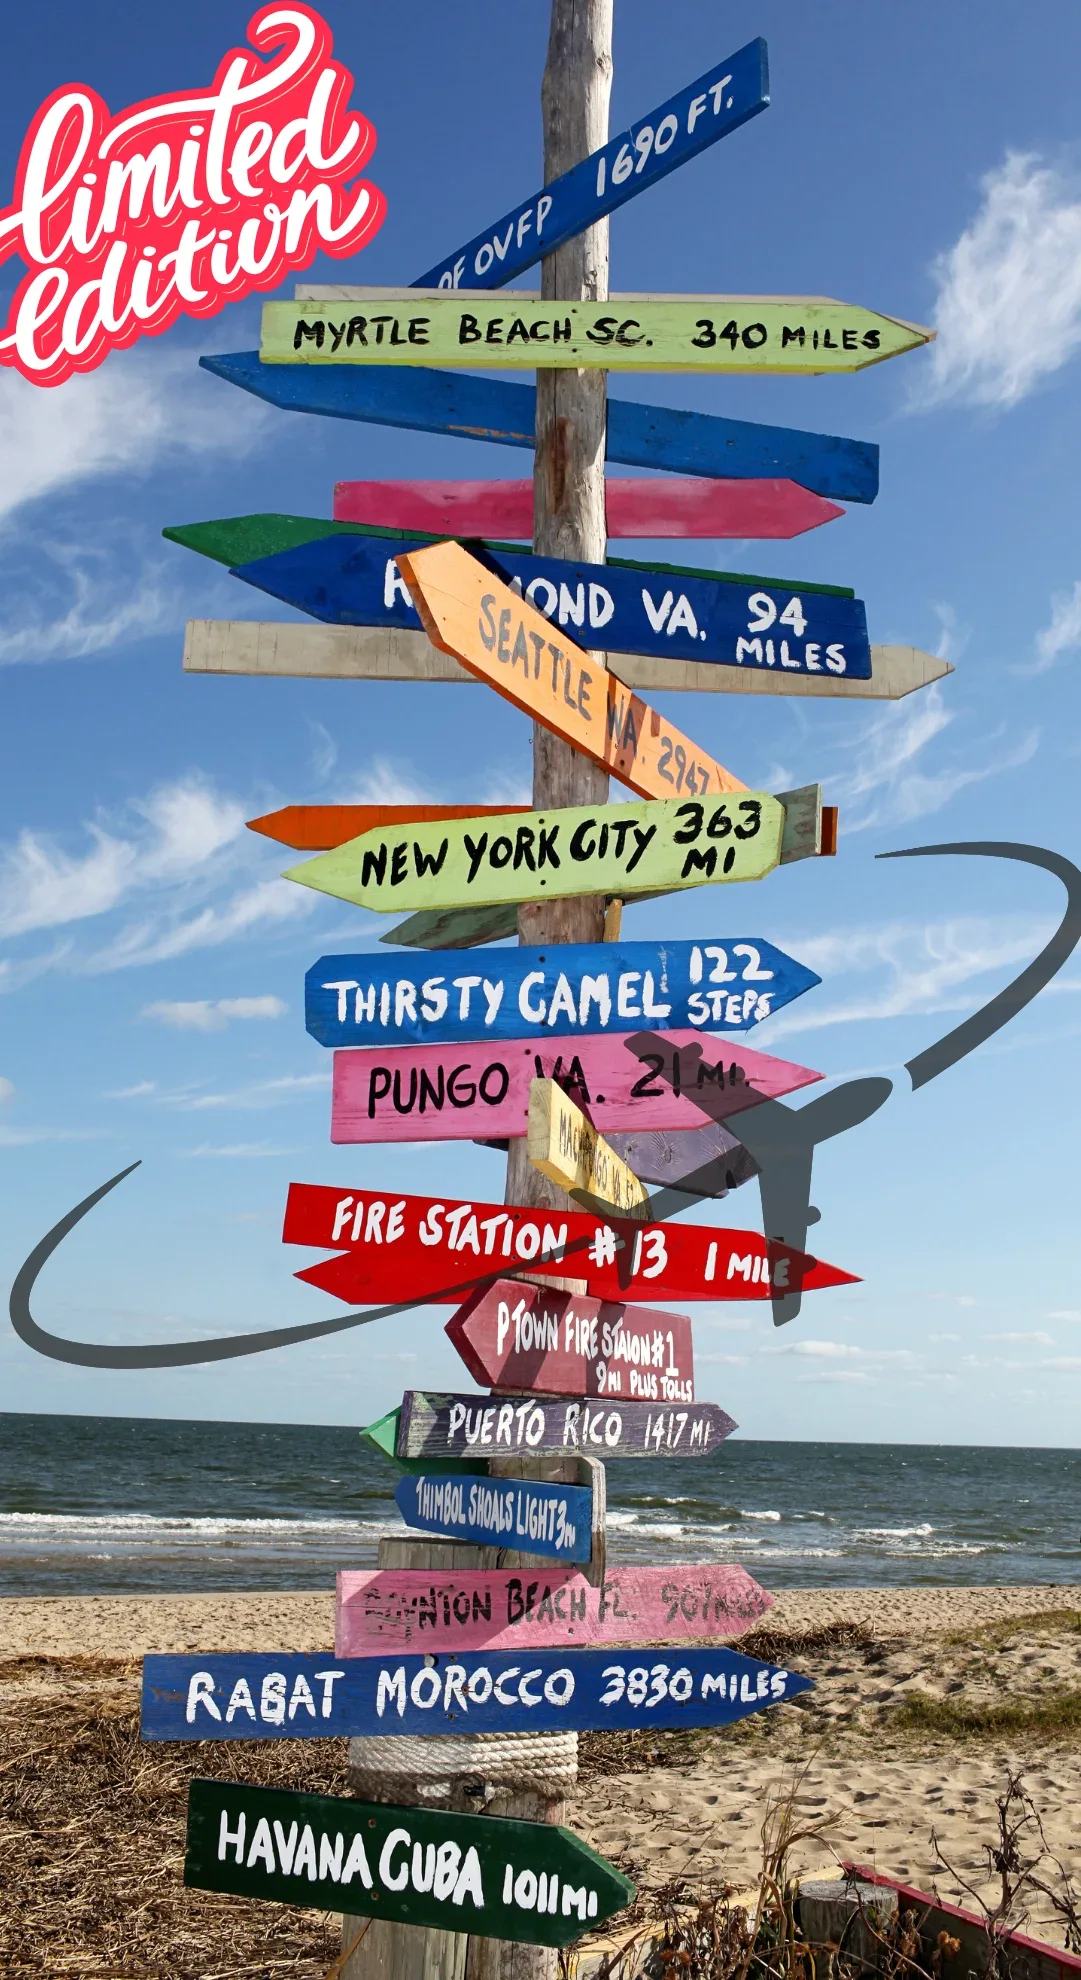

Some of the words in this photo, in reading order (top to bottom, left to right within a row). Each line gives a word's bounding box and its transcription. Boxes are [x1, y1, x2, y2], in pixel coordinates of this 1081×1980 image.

[474, 195, 553, 276] OVFP
[596, 114, 678, 197] 1690
[687, 74, 734, 135] FT.
[294, 316, 430, 353] MYRTLE
[459, 315, 571, 344] BEACH
[692, 318, 767, 350] 340
[782, 326, 881, 350] MILES
[747, 592, 808, 637] 94
[736, 637, 846, 674] MILES
[478, 594, 594, 721] SEATTLE
[657, 736, 710, 797] 2947
[360, 838, 449, 888] NEW
[463, 824, 561, 884] YORK
[570, 819, 657, 874] CITY
[672, 800, 762, 845] 363
[680, 846, 736, 880] MI
[321, 976, 505, 1028] THIRSTY
[518, 970, 672, 1027] CAMEL
[688, 943, 774, 984] 122
[687, 991, 772, 1025] STEPS
[367, 1062, 509, 1119] PUNGO
[631, 1051, 681, 1099] 21
[331, 1195, 406, 1244] FIRE
[418, 1205, 569, 1265] STATION
[704, 1241, 718, 1282] 1
[726, 1252, 791, 1288] MILE
[565, 1311, 599, 1361] FIRE
[601, 1317, 651, 1367] STAION
[630, 1369, 658, 1401] PLUS
[659, 1375, 693, 1403] TOLLS
[447, 1398, 546, 1448] PUERTO
[563, 1402, 623, 1447] RICO
[645, 1412, 689, 1452] 1417
[690, 1417, 711, 1448] MI
[416, 1476, 466, 1526] THIMBOL
[468, 1484, 514, 1534] SHOALS
[516, 1489, 557, 1542] LIGHT
[505, 1577, 586, 1626] BEACH
[661, 1581, 712, 1624] 907
[186, 1670, 346, 1726] RABAT
[376, 1664, 576, 1717] MOROCCO
[599, 1664, 694, 1708] 3830
[701, 1669, 788, 1703] MILES
[217, 1809, 373, 1890] HAVANA
[379, 1827, 486, 1908] CUBA
